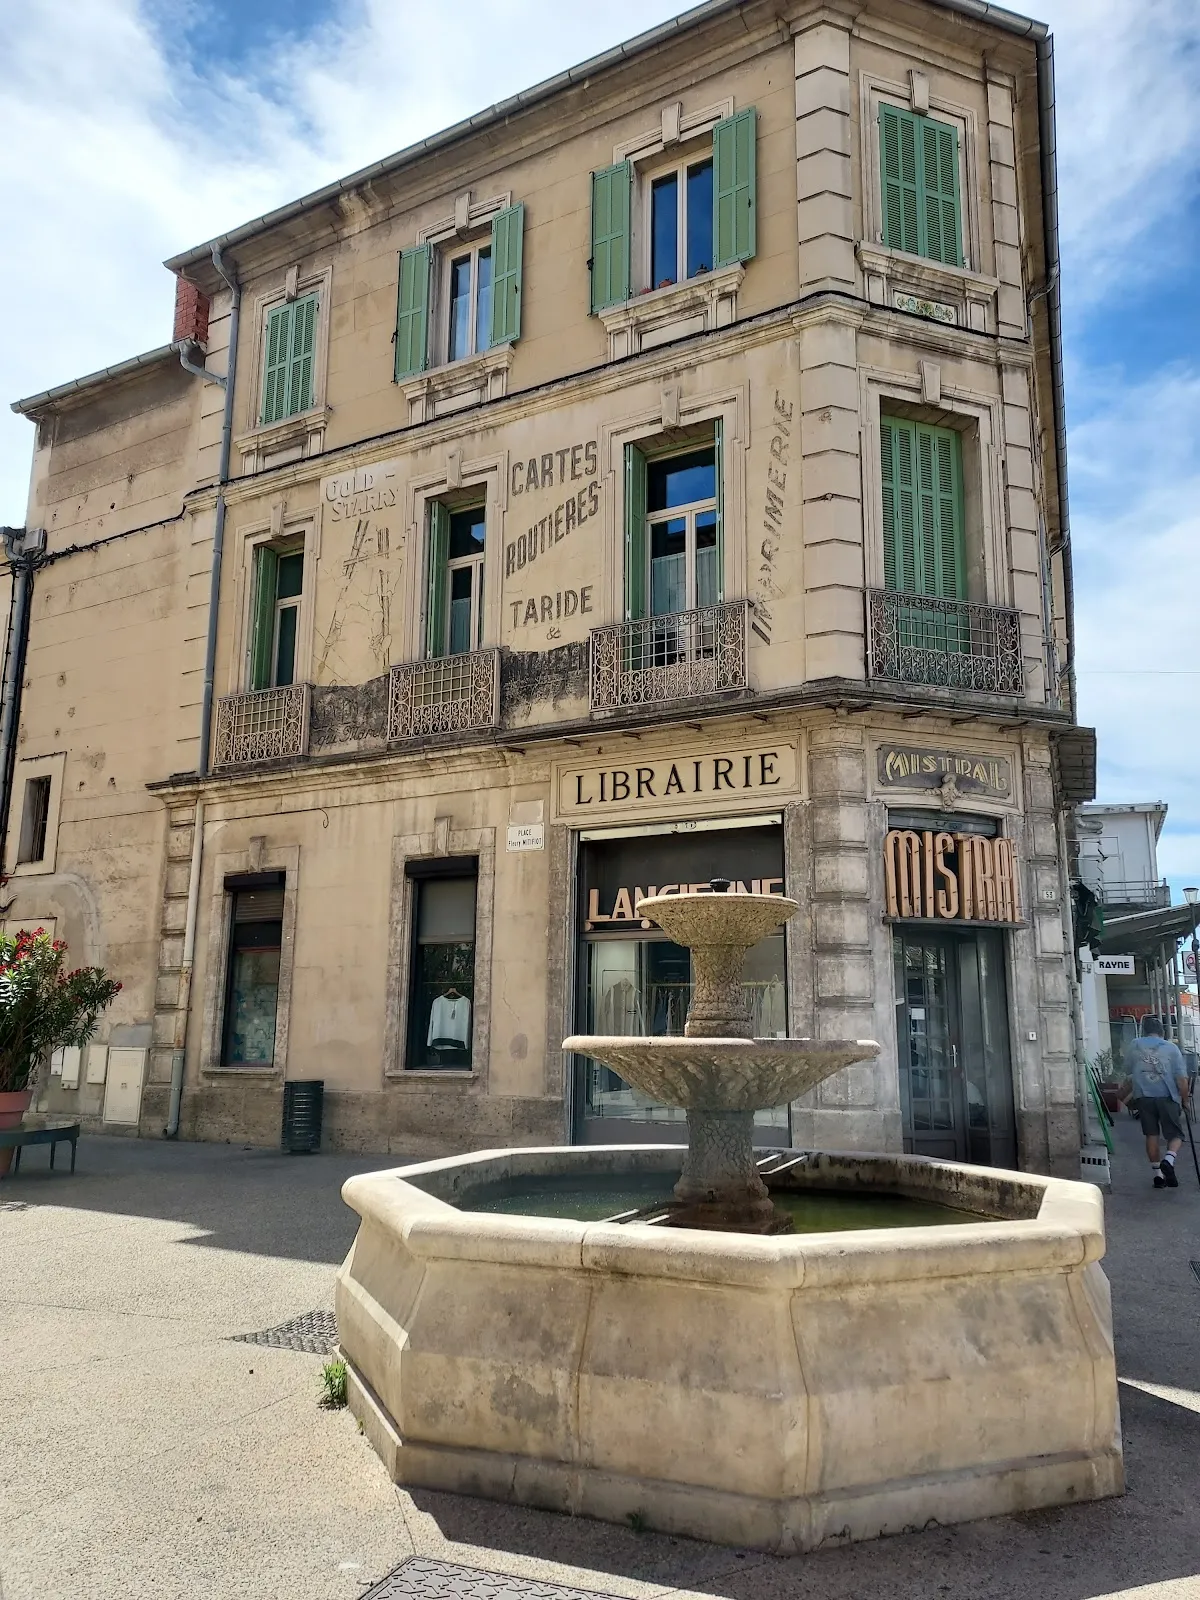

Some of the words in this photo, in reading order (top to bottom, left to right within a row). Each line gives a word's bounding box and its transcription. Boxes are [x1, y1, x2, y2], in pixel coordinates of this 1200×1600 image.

[511, 440, 597, 497] CARTES
[510, 585, 593, 629] TARIDE
[575, 752, 781, 805] LIBRAIRIE
[885, 751, 1008, 791] MISTRAL
[1098, 961, 1130, 969] RAYNE
